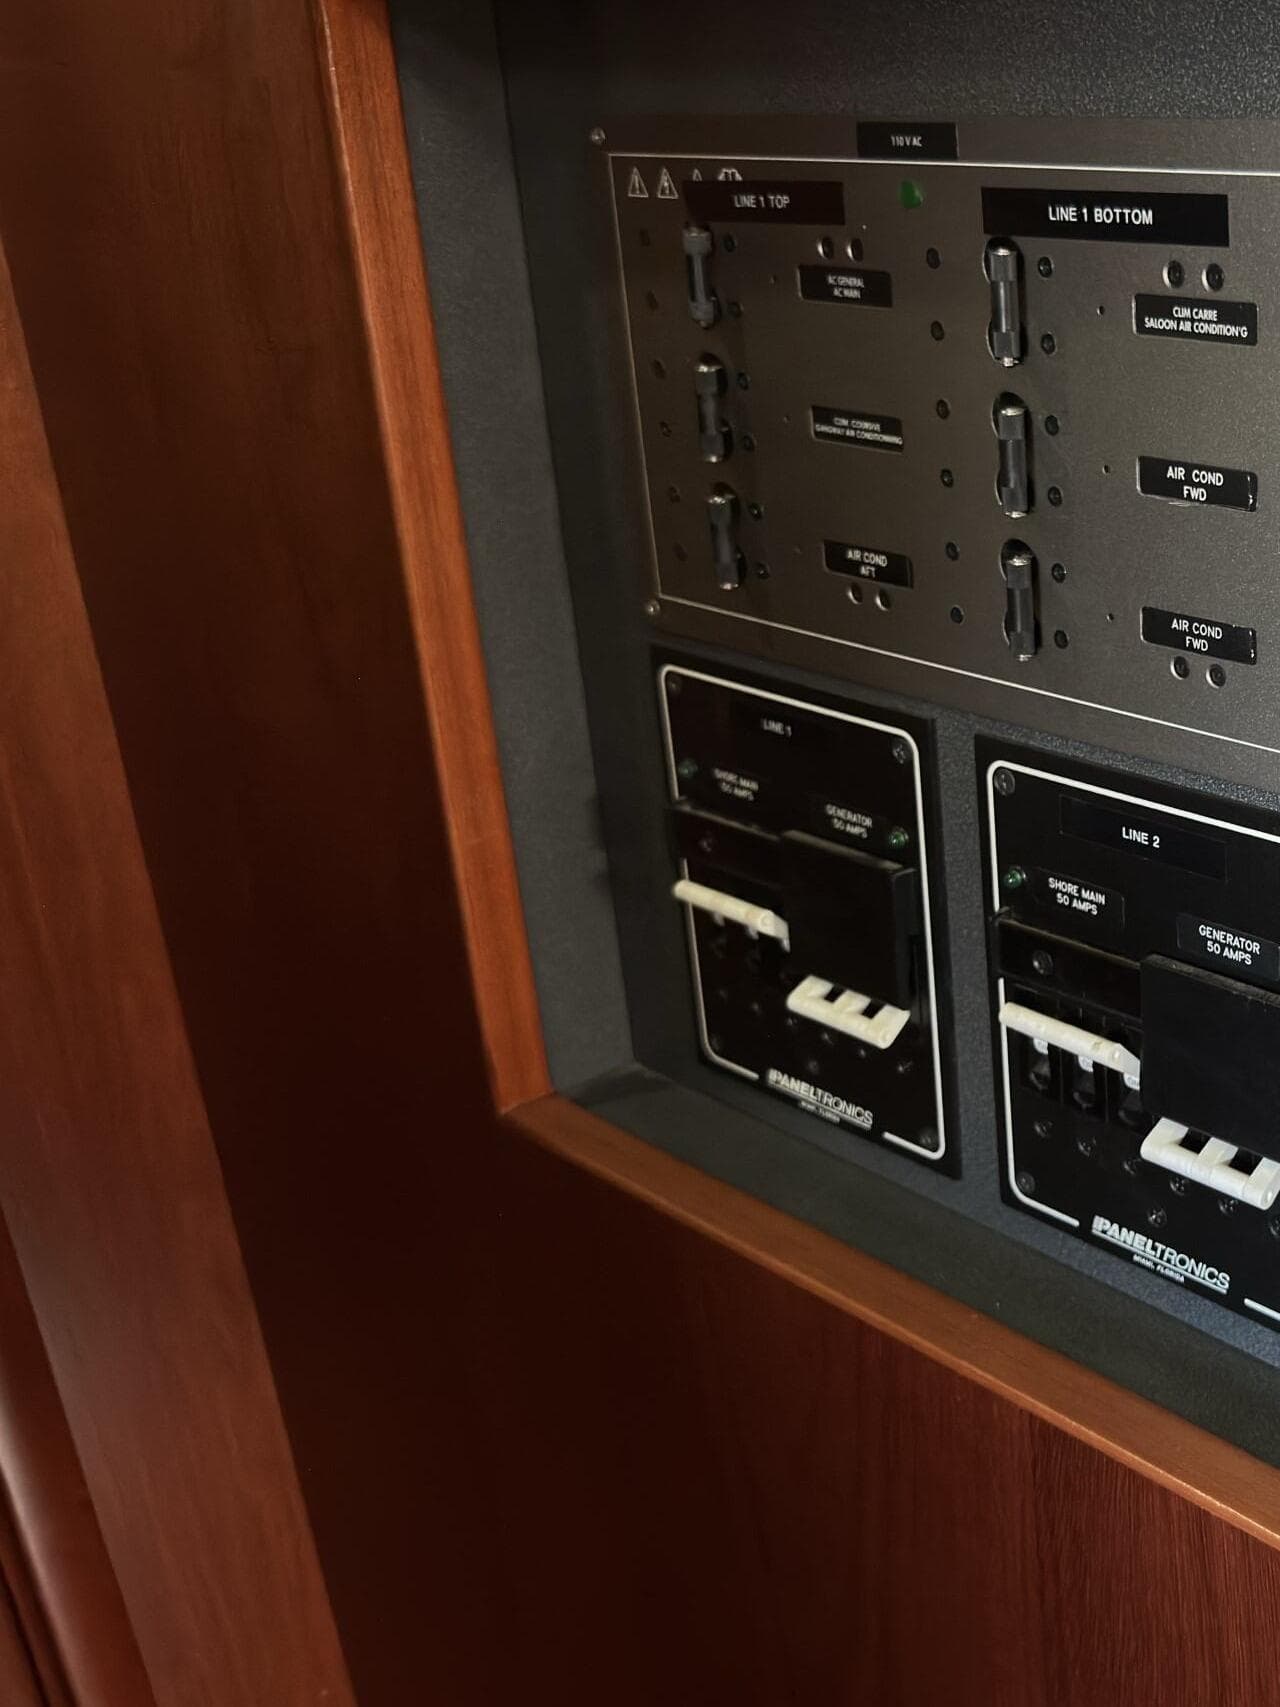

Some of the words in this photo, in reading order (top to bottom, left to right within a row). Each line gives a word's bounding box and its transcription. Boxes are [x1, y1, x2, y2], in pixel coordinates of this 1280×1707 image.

[734, 194, 757, 208] LINE
[759, 195, 765, 208] 1
[768, 194, 790, 209] TOP
[1048, 205, 1077, 221] LINE
[1082, 207, 1088, 222] 1
[1094, 207, 1153, 225] BOTTOM
[1173, 306, 1191, 319] CLIM
[1193, 308, 1218, 322] CARRE
[1144, 317, 1177, 331] SALOON
[1179, 320, 1192, 332] AIR
[1193, 322, 1248, 338] CONDITION'G
[1167, 466, 1185, 481] AIR
[1192, 469, 1224, 487] COND
[1183, 486, 1207, 502] FWD
[847, 549, 862, 561] AIR
[863, 552, 888, 568] COND
[1171, 618, 1189, 633] AIR
[1192, 622, 1223, 640] COND
[1186, 636, 1208, 652] FWD
[763, 718, 784, 736] LINE
[786, 725, 792, 738] 1
[825, 803, 873, 829] GENERATOR
[846, 823, 869, 840] AMPS
[1121, 826, 1149, 846] LINE
[1152, 834, 1161, 849] 2
[1048, 877, 1079, 898] SHORE
[1081, 887, 1106, 906] MAIN
[1056, 892, 1070, 906] 50
[1072, 898, 1098, 916] AMPS
[1199, 924, 1261, 956] GENERATOR
[1207, 940, 1221, 954] 50
[1223, 948, 1252, 966] AMPS
[768, 1067, 874, 1126] PANELTRONICS
[1092, 1214, 1231, 1290] PANELTRONICS
